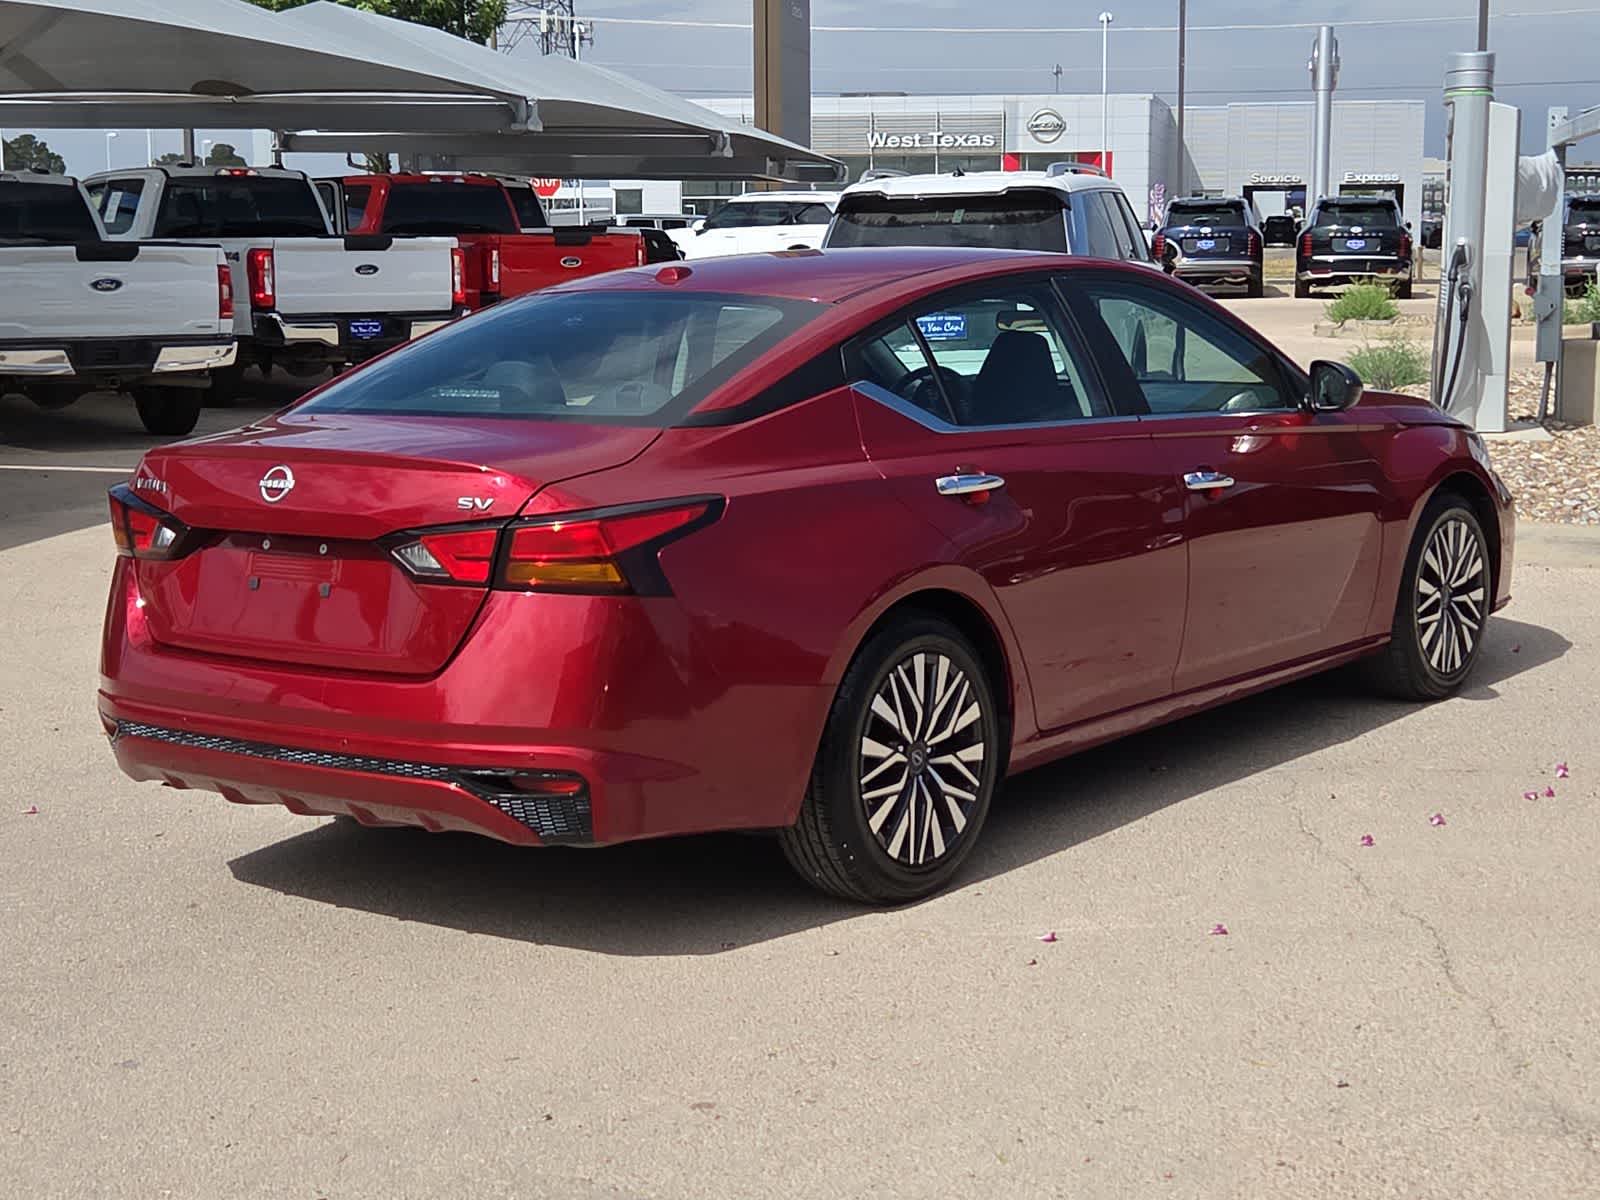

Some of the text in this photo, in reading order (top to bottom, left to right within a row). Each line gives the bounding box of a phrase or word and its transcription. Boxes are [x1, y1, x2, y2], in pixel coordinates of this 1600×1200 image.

[866, 130, 996, 148] West Texas
[1250, 172, 1302, 184] Service
[1343, 171, 1401, 184] Express
[927, 322, 943, 332] You
[457, 496, 494, 510] SV
